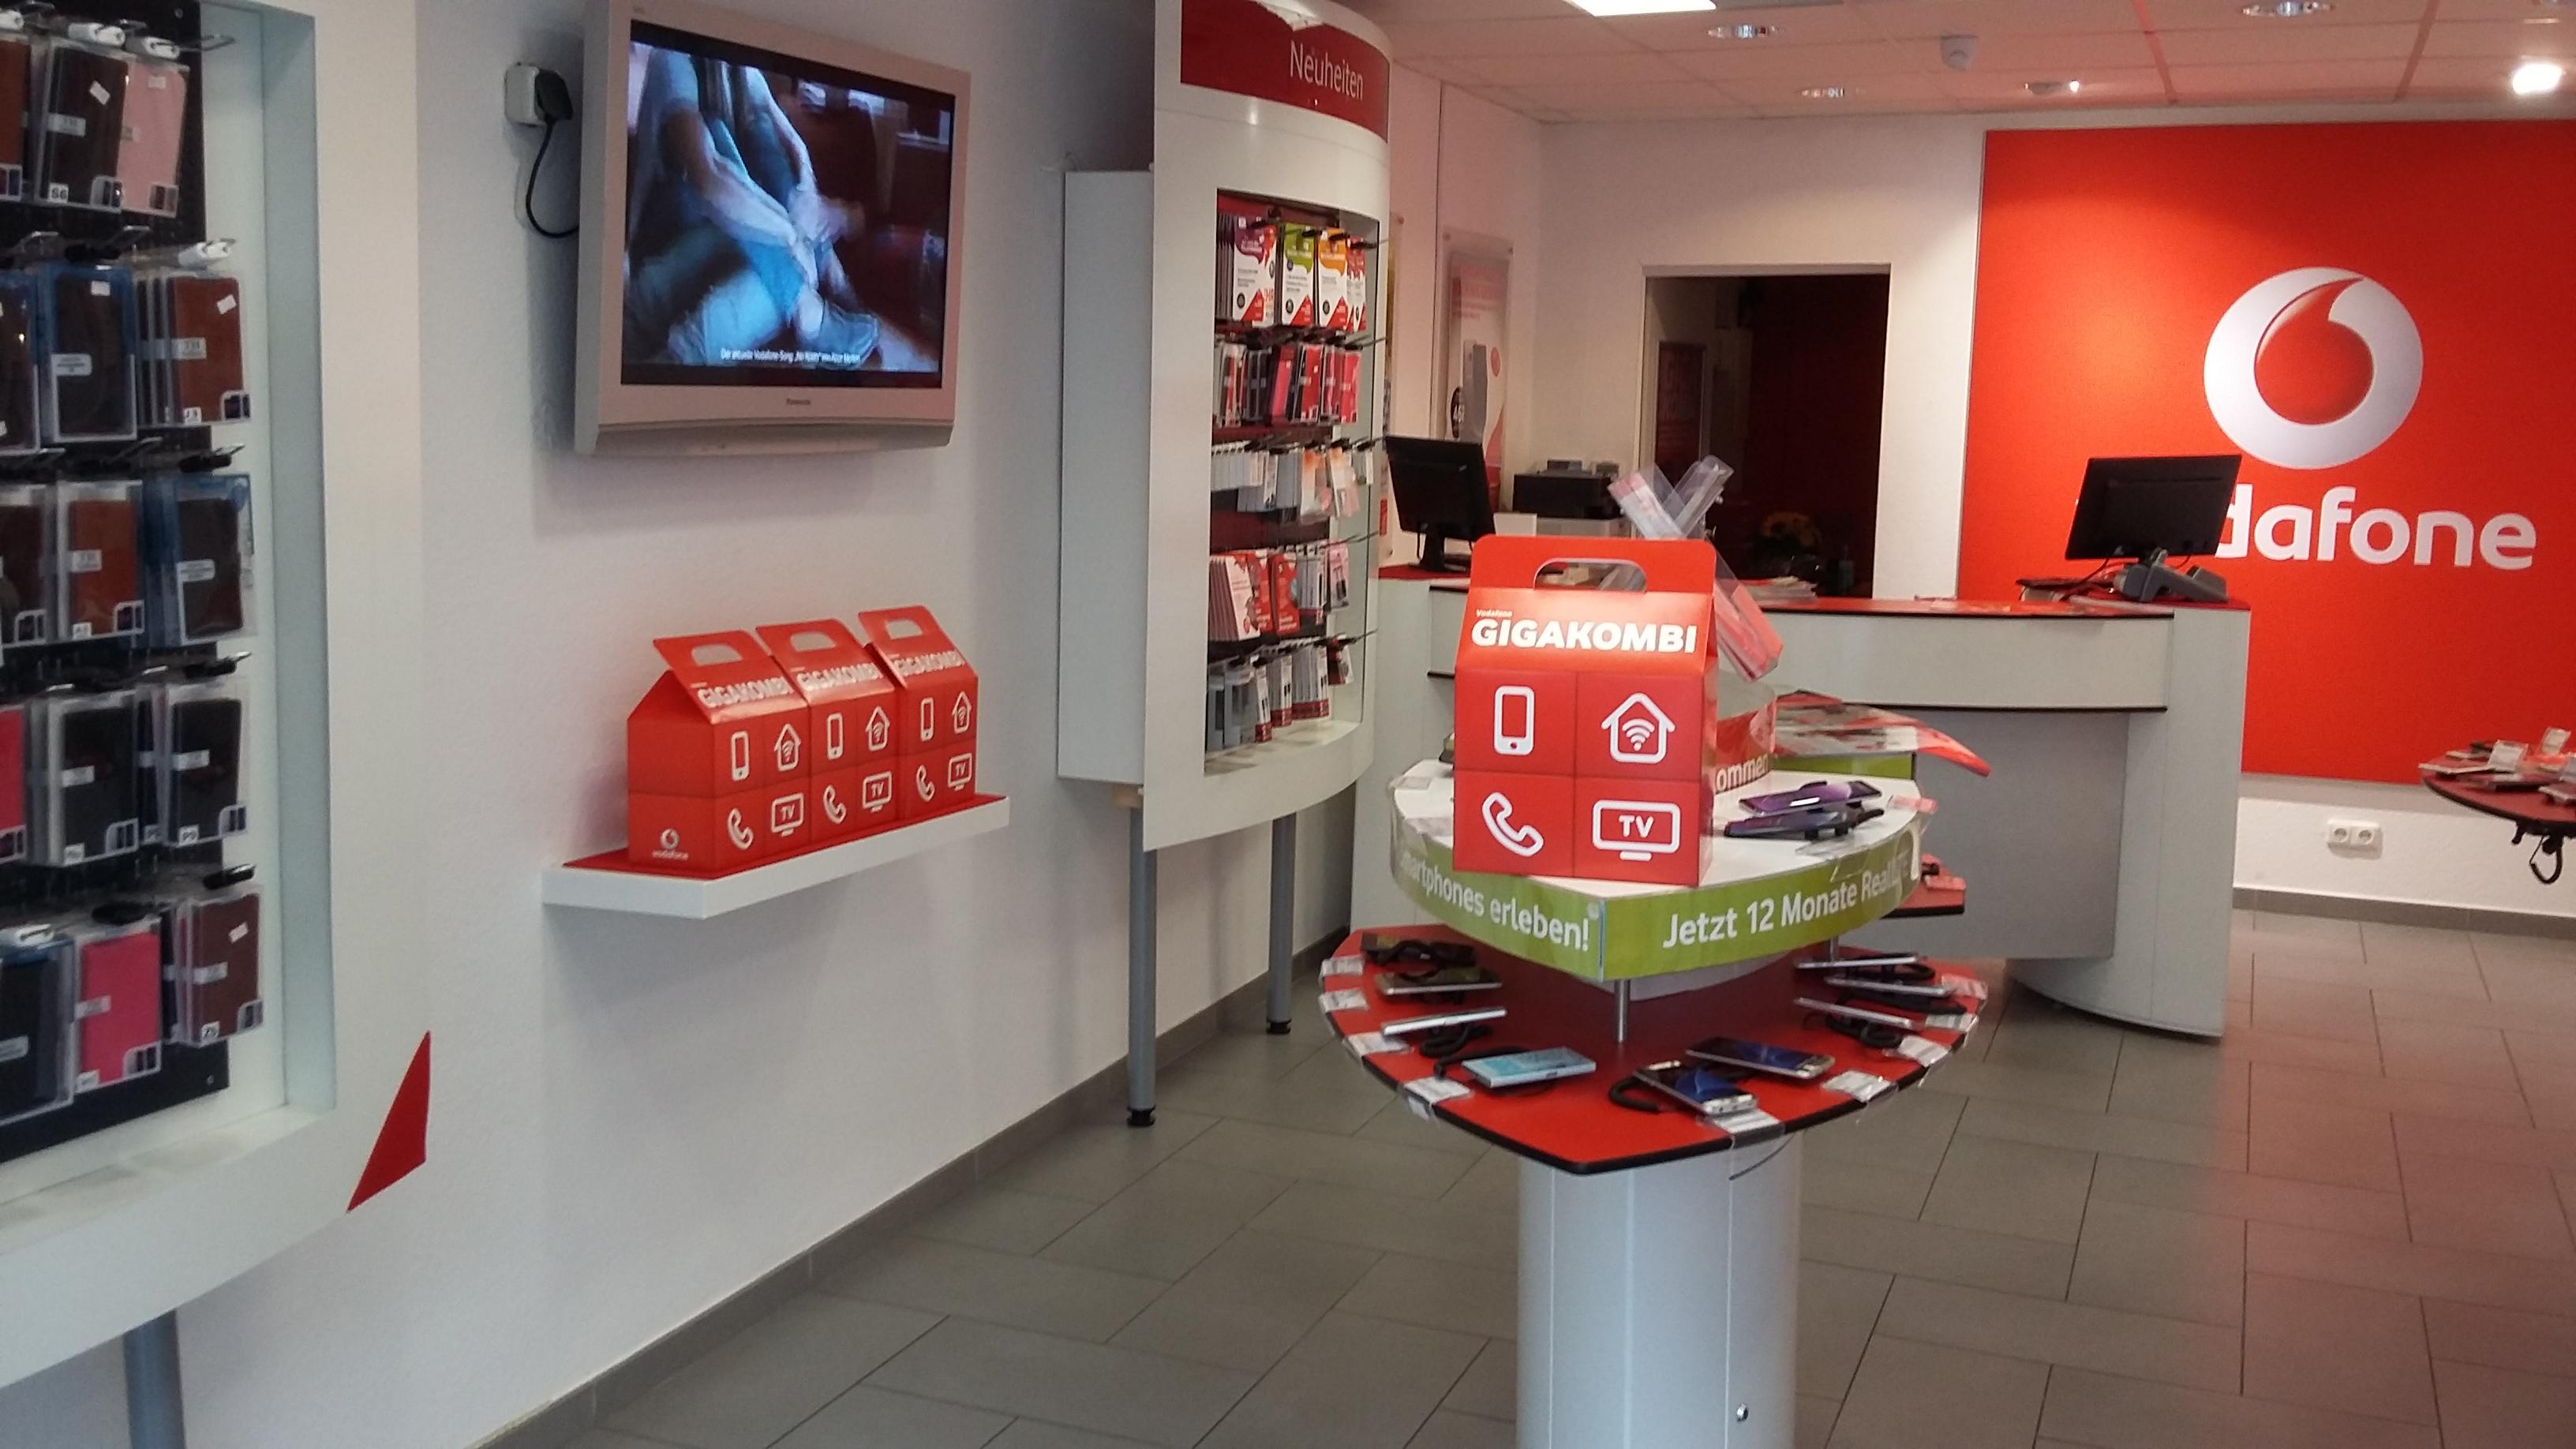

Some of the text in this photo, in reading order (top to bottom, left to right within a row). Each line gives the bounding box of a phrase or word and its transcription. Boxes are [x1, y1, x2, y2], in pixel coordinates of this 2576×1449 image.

[1290, 40, 1364, 100] Neuheiten
[2215, 483, 2537, 570] dafone
[1476, 609, 1513, 618] Vodafone
[1471, 619, 1698, 653] GIGAKOMBI
[698, 676, 794, 708] GIGAKOMBI
[796, 663, 884, 691] GIGAKOMBI
[955, 761, 965, 776] TV
[1716, 753, 1769, 792] ommen
[871, 782, 885, 797] TV
[781, 804, 795, 820] TV
[1619, 814, 1654, 838] TV
[1402, 852, 1589, 952] artphones erleben!
[1662, 908, 1738, 949] Jetzt
[1747, 897, 1774, 934] 12
[1780, 882, 1858, 927] Monate
